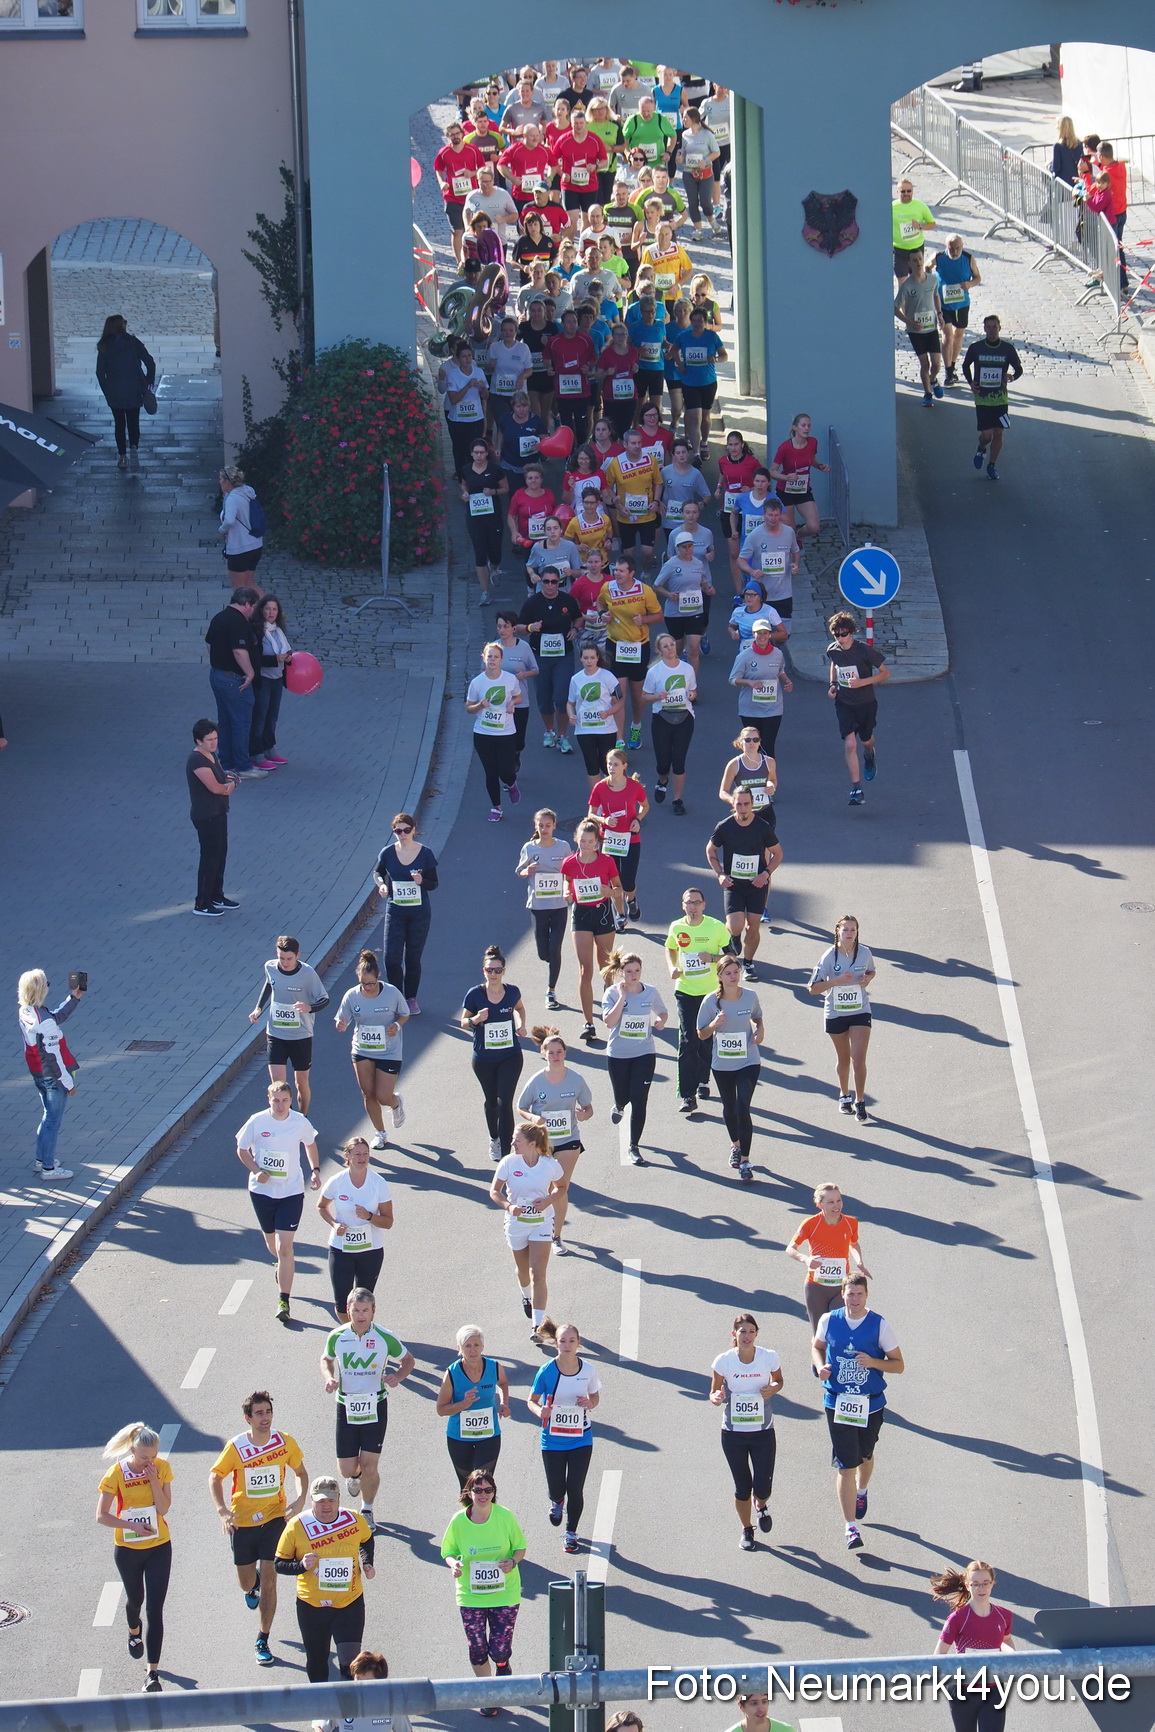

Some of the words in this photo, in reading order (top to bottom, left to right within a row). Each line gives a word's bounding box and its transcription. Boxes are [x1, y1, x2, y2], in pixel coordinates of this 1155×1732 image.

[455, 180, 469, 190] 5114
[616, 382, 632, 391] 5115
[460, 404, 475, 412] 5102
[622, 470, 637, 480] MAX
[473, 498, 490, 507] 5034
[765, 558, 782, 566] 5219
[628, 596, 645, 604] BÖGL
[682, 596, 700, 604] 5193
[544, 640, 561, 648] 5056
[665, 695, 684, 704] 5048
[485, 712, 502, 720] 5047
[607, 836, 626, 847] 5123
[736, 861, 754, 870] 5011
[538, 879, 558, 888] 5179
[397, 887, 416, 896] 5136
[578, 884, 598, 893] 5110
[838, 992, 857, 1001] 5007
[276, 1010, 296, 1019] 5063
[362, 1032, 381, 1041] 5044
[489, 1029, 508, 1038] 5135
[722, 1040, 742, 1048] 5094
[547, 1118, 566, 1127] 5006
[263, 1157, 284, 1167] 5200
[346, 1232, 366, 1242] 5201
[820, 1266, 841, 1275] 5026
[845, 1385, 860, 1394] 3x3
[350, 1402, 371, 1412] 5071
[736, 1402, 759, 1412] 5054
[840, 1402, 863, 1414] 5051
[466, 1416, 488, 1427] 5078
[556, 1414, 579, 1424] 8010
[244, 1458, 264, 1468] MAX
[266, 1449, 288, 1461] BÖGL
[251, 1474, 275, 1485] 5213
[311, 1536, 335, 1550] MAX
[337, 1526, 360, 1540] BÖGL
[325, 1567, 348, 1578] 5096
[475, 1569, 500, 1580] 5030
